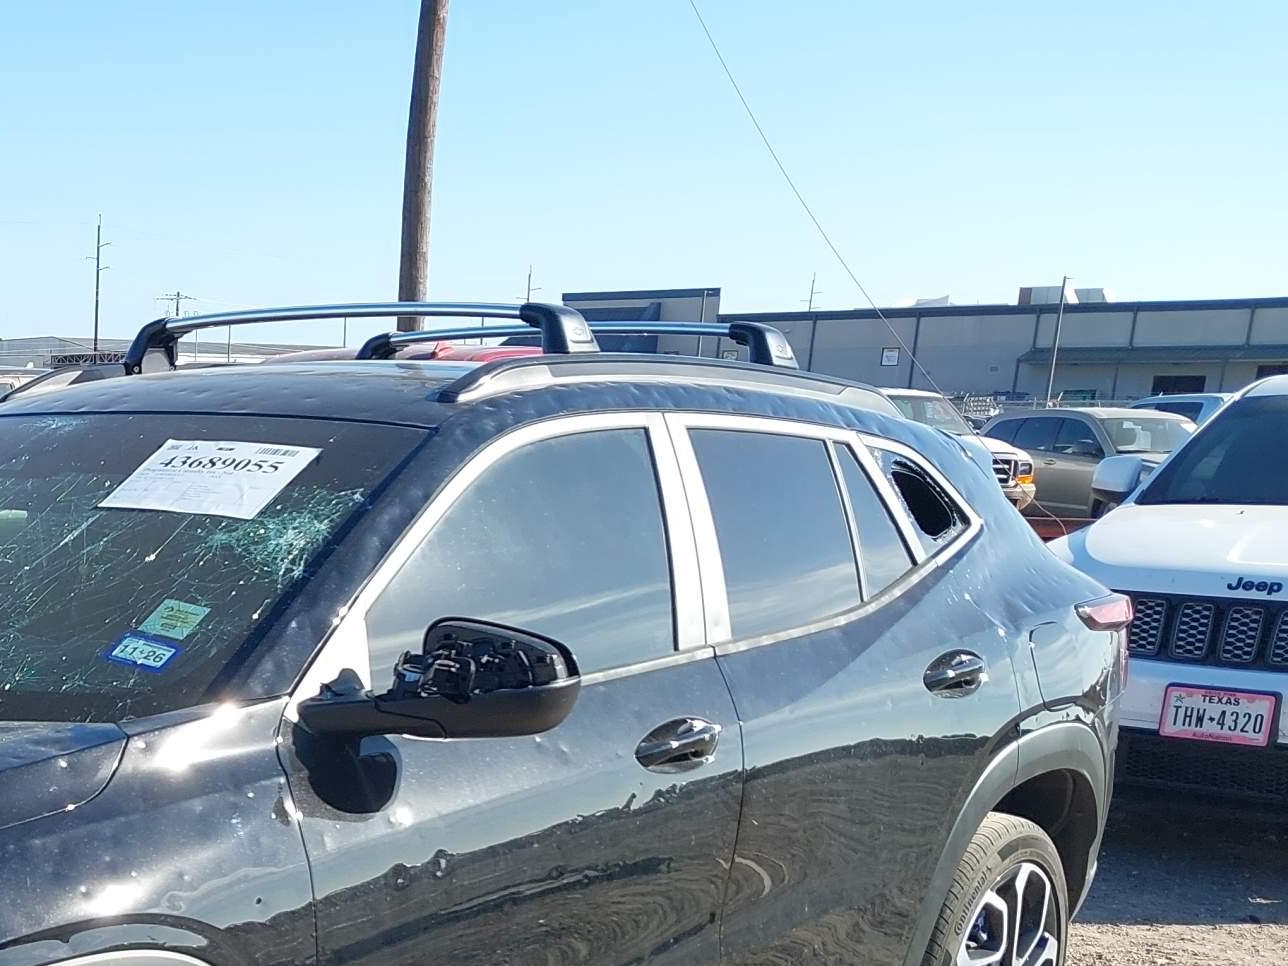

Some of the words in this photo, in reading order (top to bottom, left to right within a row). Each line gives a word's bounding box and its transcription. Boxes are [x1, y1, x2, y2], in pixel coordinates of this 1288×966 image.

[160, 455, 286, 474] 43689055
[1226, 576, 1283, 596] Jeep
[1201, 695, 1241, 706] TEXAS
